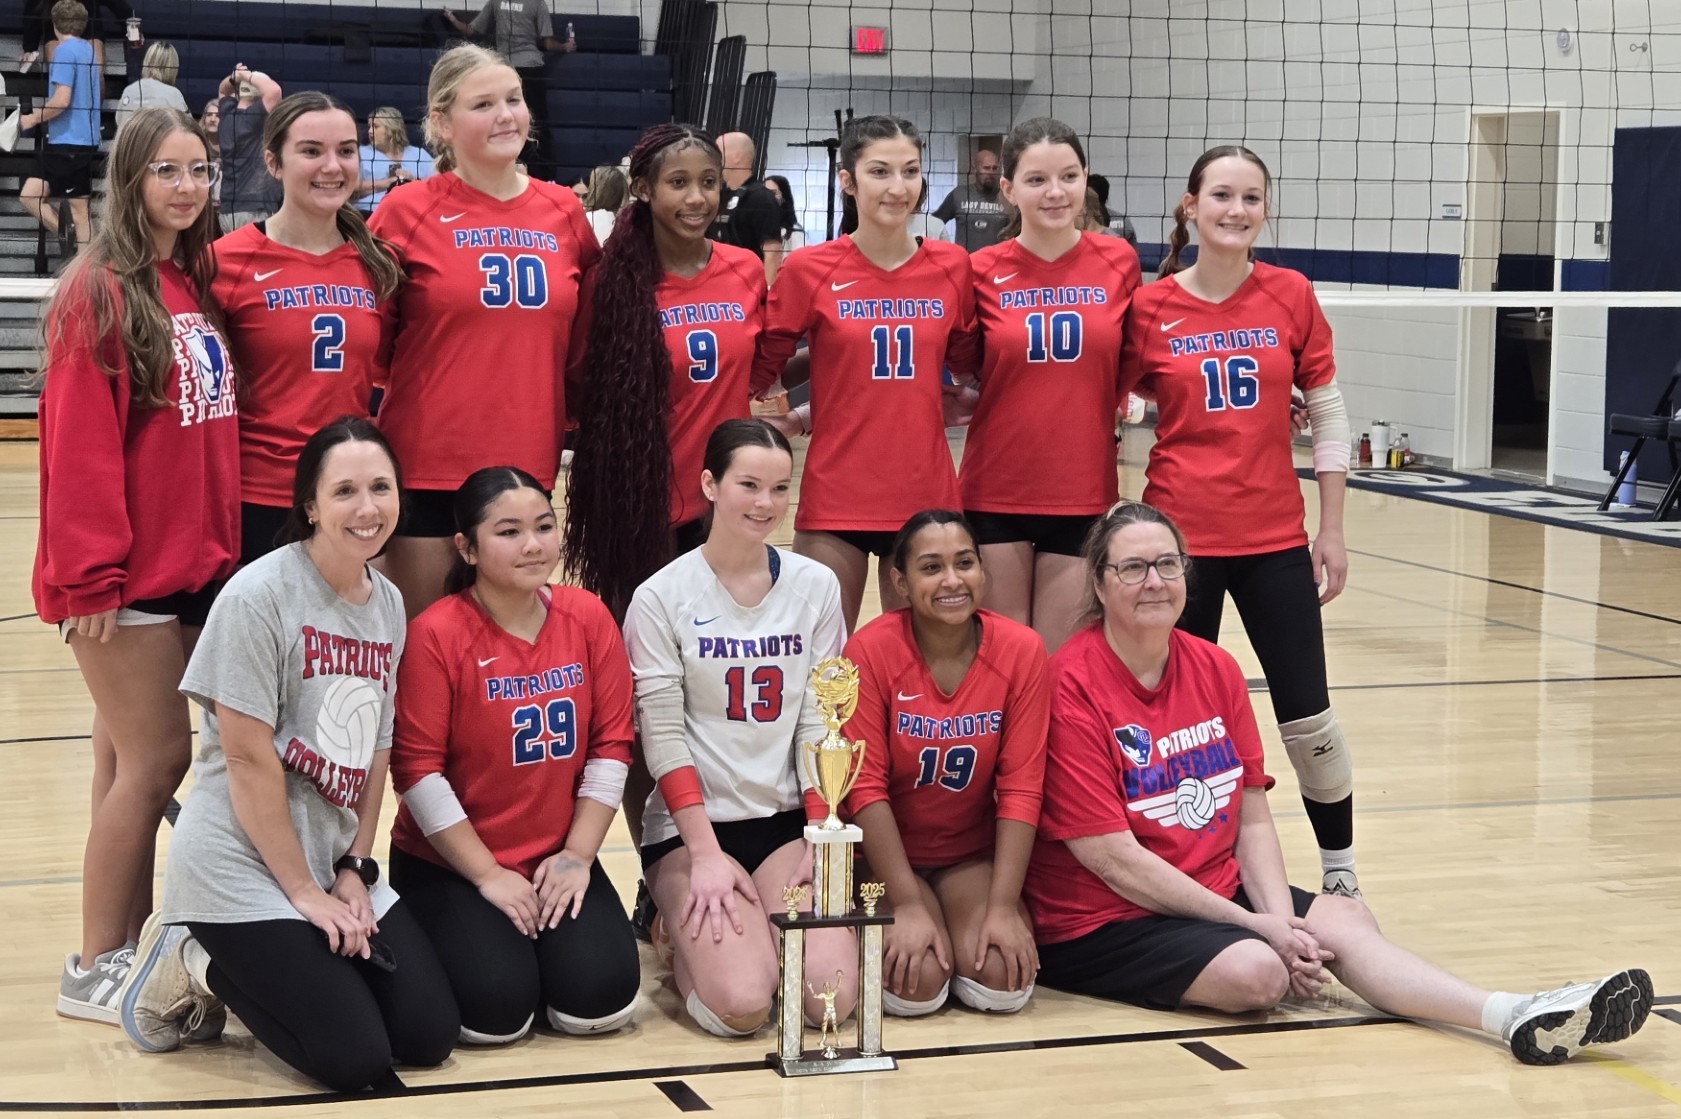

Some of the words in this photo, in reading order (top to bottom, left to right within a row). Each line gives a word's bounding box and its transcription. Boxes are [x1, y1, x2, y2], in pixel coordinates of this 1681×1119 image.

[453, 226, 559, 253] PATRIOTS
[263, 284, 376, 311] PATRIOTS
[479, 253, 549, 309] 30
[999, 286, 1107, 309] PATRIOTS
[659, 302, 745, 328] ATRIOTS
[837, 298, 944, 319] PATRIOTS
[311, 313, 346, 372] 2
[686, 329, 718, 383] 9
[871, 324, 915, 380] 11
[1025, 310, 1083, 363] 10
[1168, 327, 1279, 357] PATRIOTS
[1200, 355, 1259, 412] 16
[697, 633, 803, 658] PATRIOTS
[485, 662, 584, 701] PATRIOTS
[725, 665, 784, 723] 13
[511, 696, 577, 767] 29
[897, 710, 1003, 740] PATRIOTS
[914, 744, 978, 792] 19
[1122, 738, 1242, 799] VOLLEYBALL
[860, 882, 886, 899] 2025
